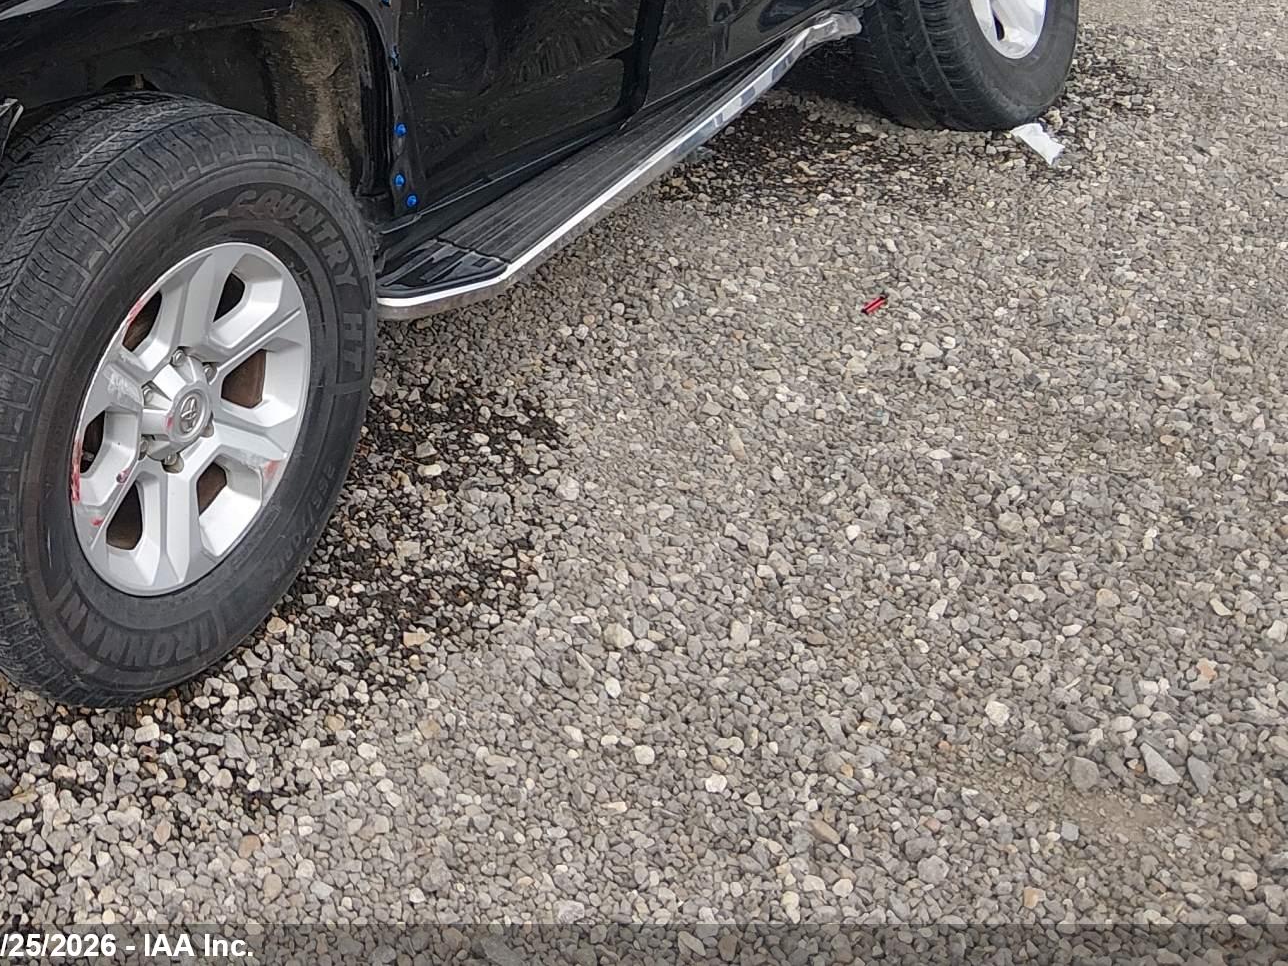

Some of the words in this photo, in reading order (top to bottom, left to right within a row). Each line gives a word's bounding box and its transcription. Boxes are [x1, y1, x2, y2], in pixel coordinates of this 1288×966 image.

[228, 189, 360, 287] COUNTRY
[342, 312, 363, 373] HT
[61, 593, 213, 667] IRONMAN
